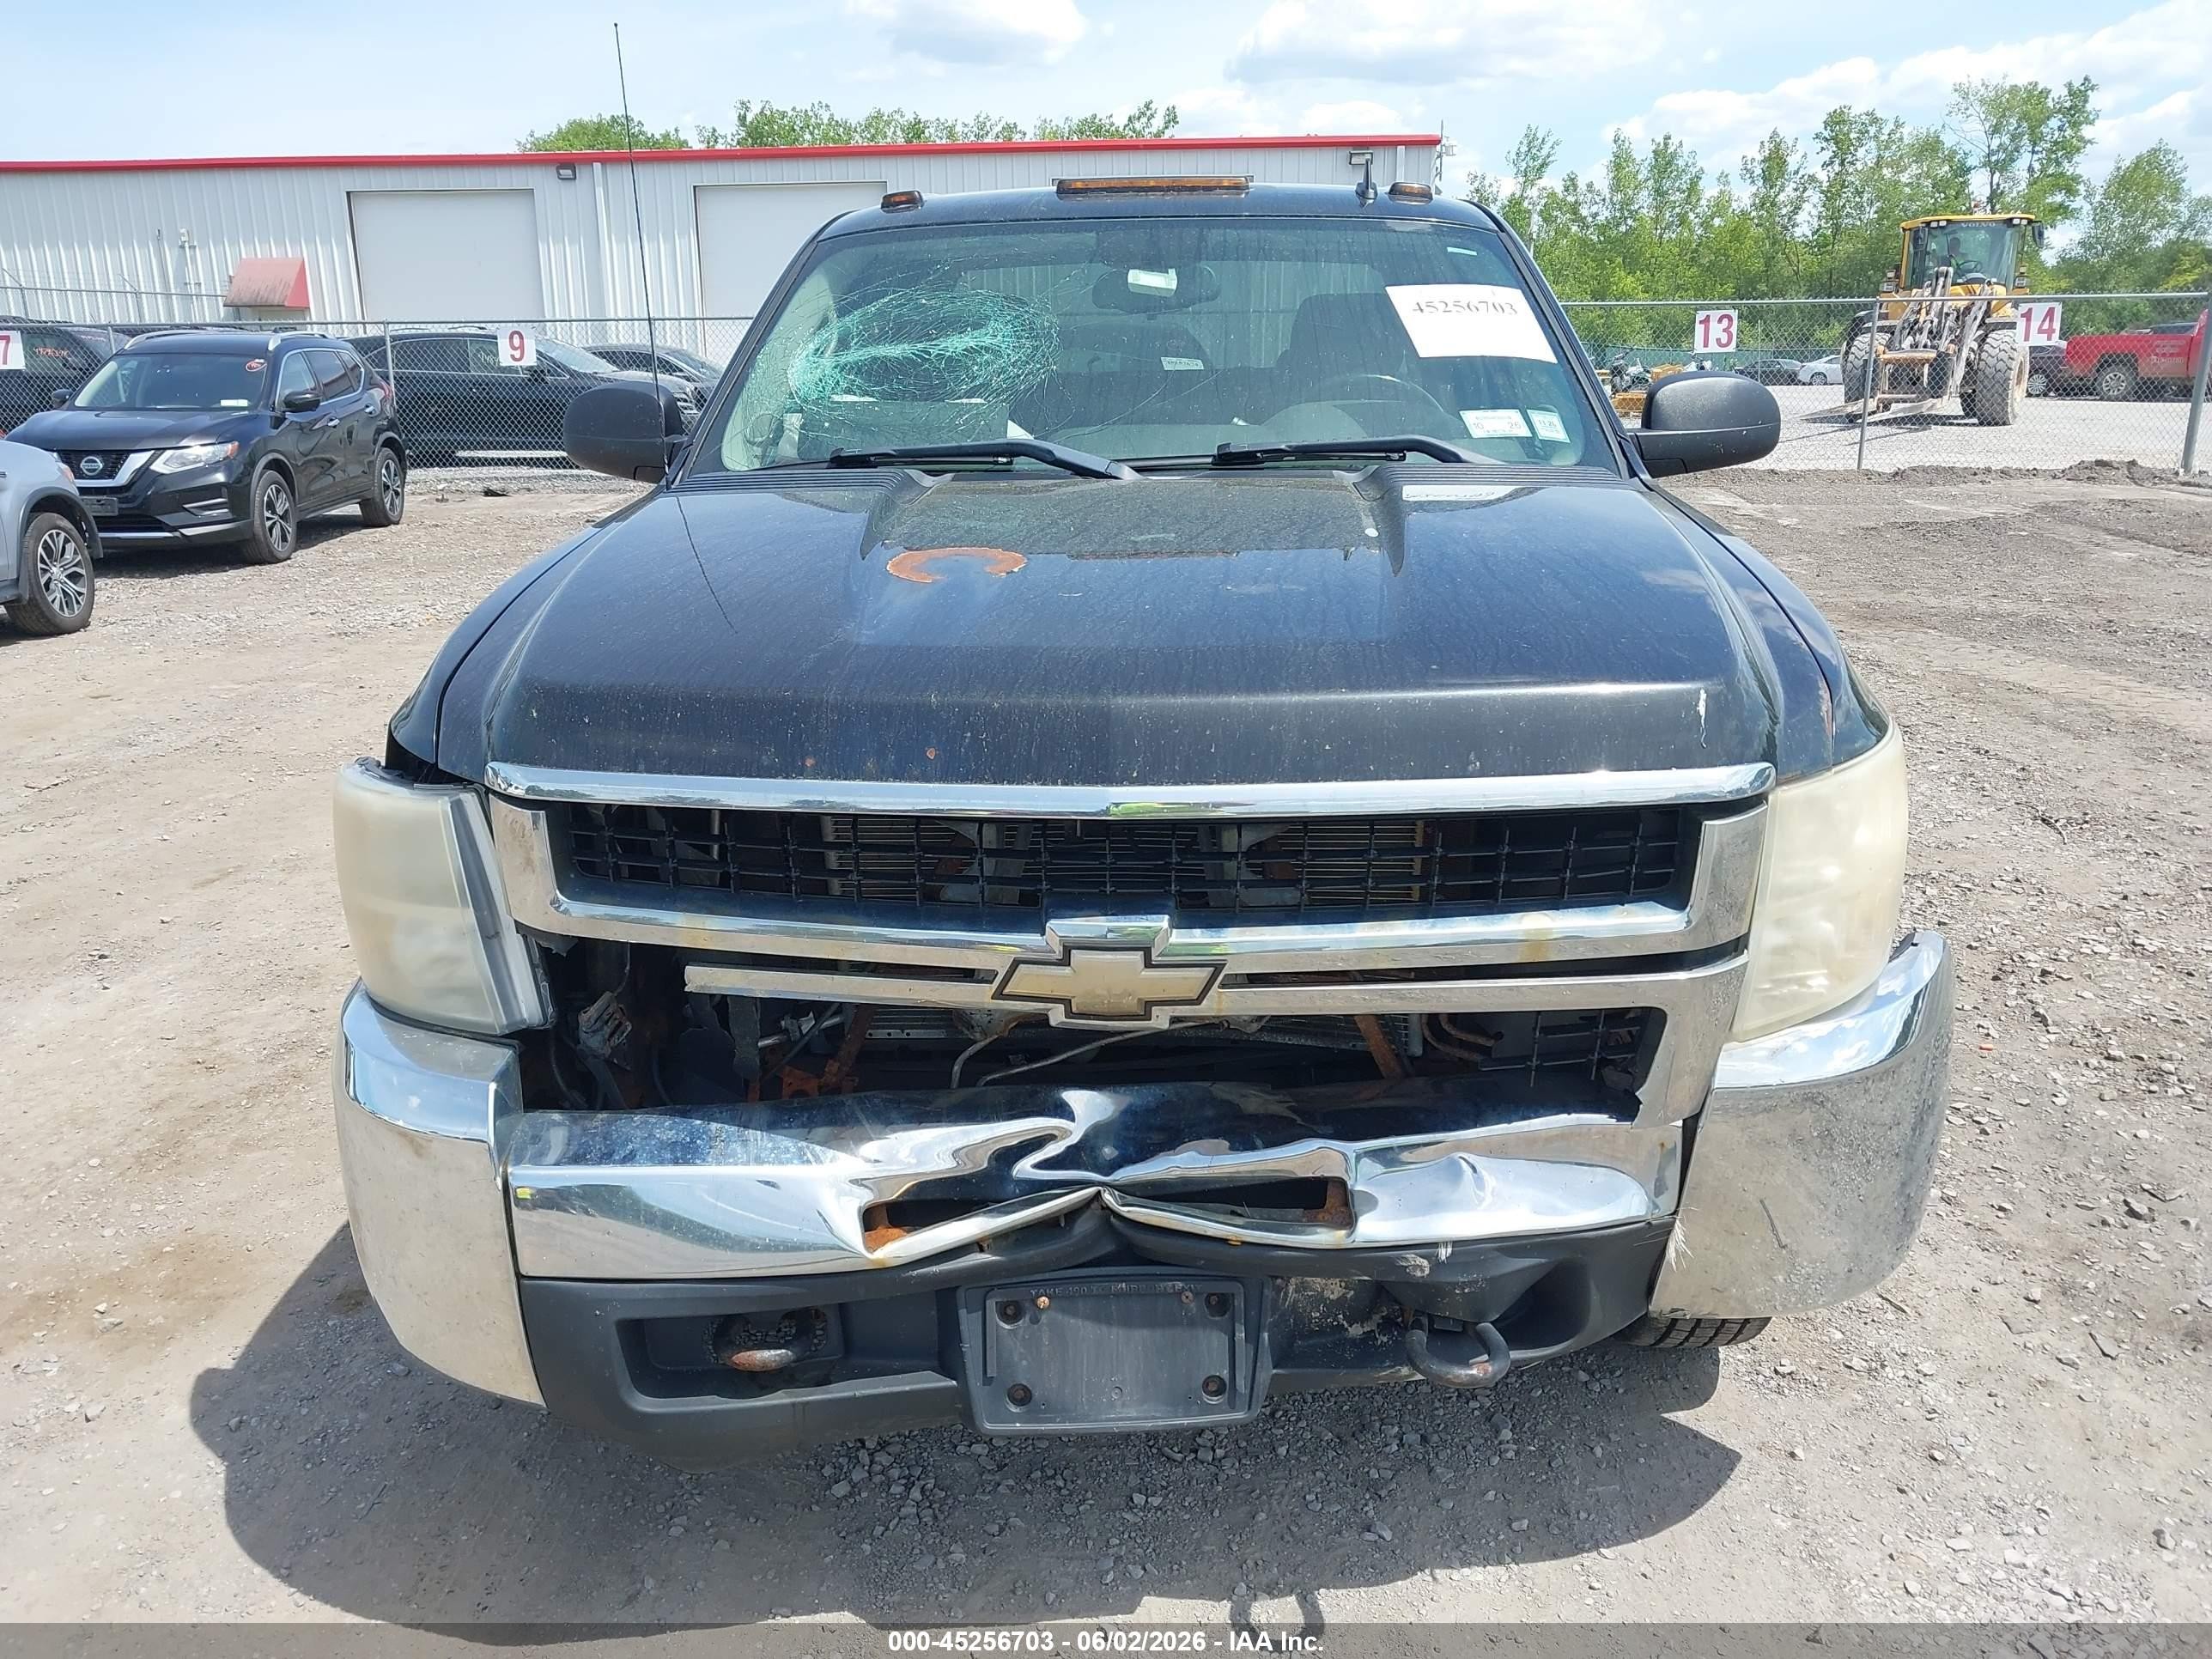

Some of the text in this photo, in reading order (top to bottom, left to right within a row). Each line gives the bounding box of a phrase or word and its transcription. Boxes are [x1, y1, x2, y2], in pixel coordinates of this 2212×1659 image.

[1413, 301, 1518, 315] 45256703
[2020, 307, 2057, 342] 14
[508, 330, 526, 362] 9
[1698, 313, 1734, 349] 13
